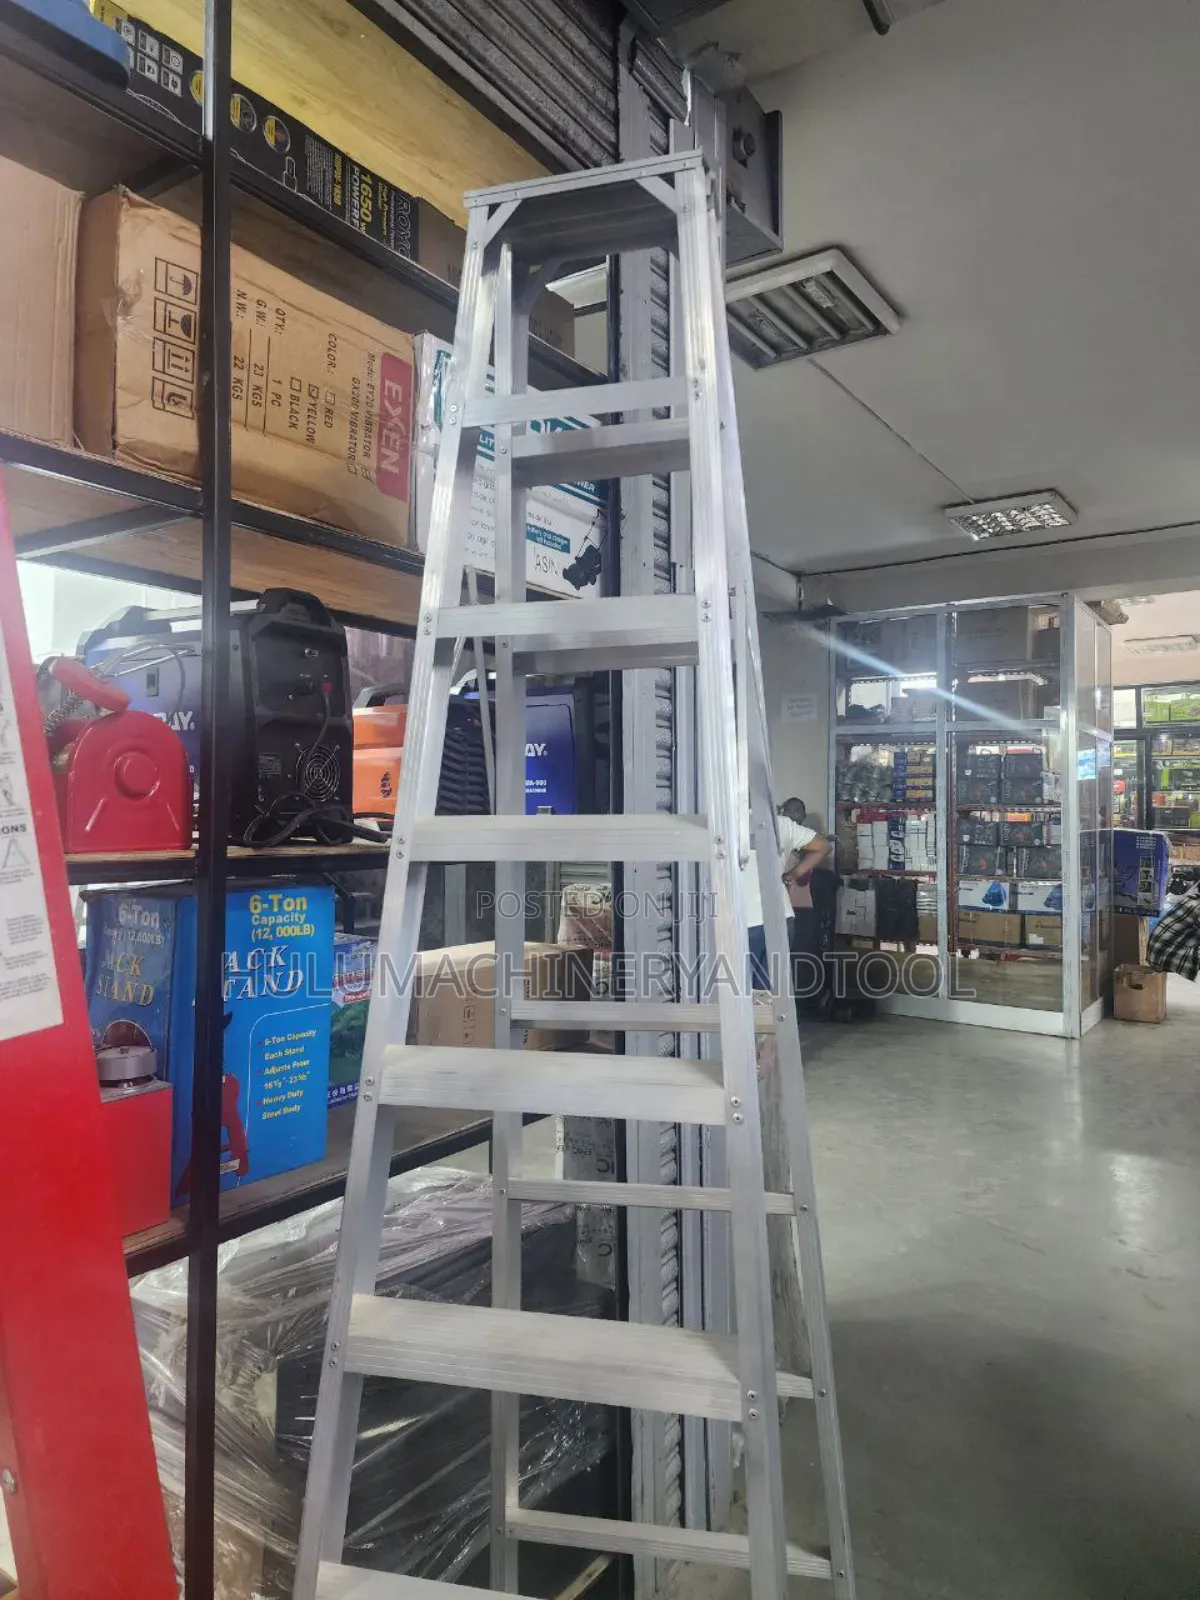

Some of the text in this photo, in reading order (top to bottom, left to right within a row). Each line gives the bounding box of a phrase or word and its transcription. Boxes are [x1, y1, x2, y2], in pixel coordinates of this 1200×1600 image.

[360, 173, 372, 222] 1650
[233, 355, 244, 371] 22
[254, 363, 264, 377] 23
[232, 377, 243, 400] KGS
[252, 384, 263, 407] KGS
[270, 392, 282, 407] PC
[288, 394, 302, 430] BLACK
[306, 401, 317, 443] YELLOW
[324, 408, 334, 428] RED
[347, 411, 360, 463] VIBRATOR
[362, 411, 374, 458] VIBRATOR
[381, 379, 405, 474] EXEN
[250, 893, 307, 914] 6-Ton
[252, 912, 306, 926] Capacity
[224, 945, 290, 972] ACK
[223, 969, 304, 1002] TAND
[286, 1029, 317, 1041] Capacity
[264, 1045, 305, 1060] Each Stand
[263, 1089, 304, 1105] Heavy Duty
